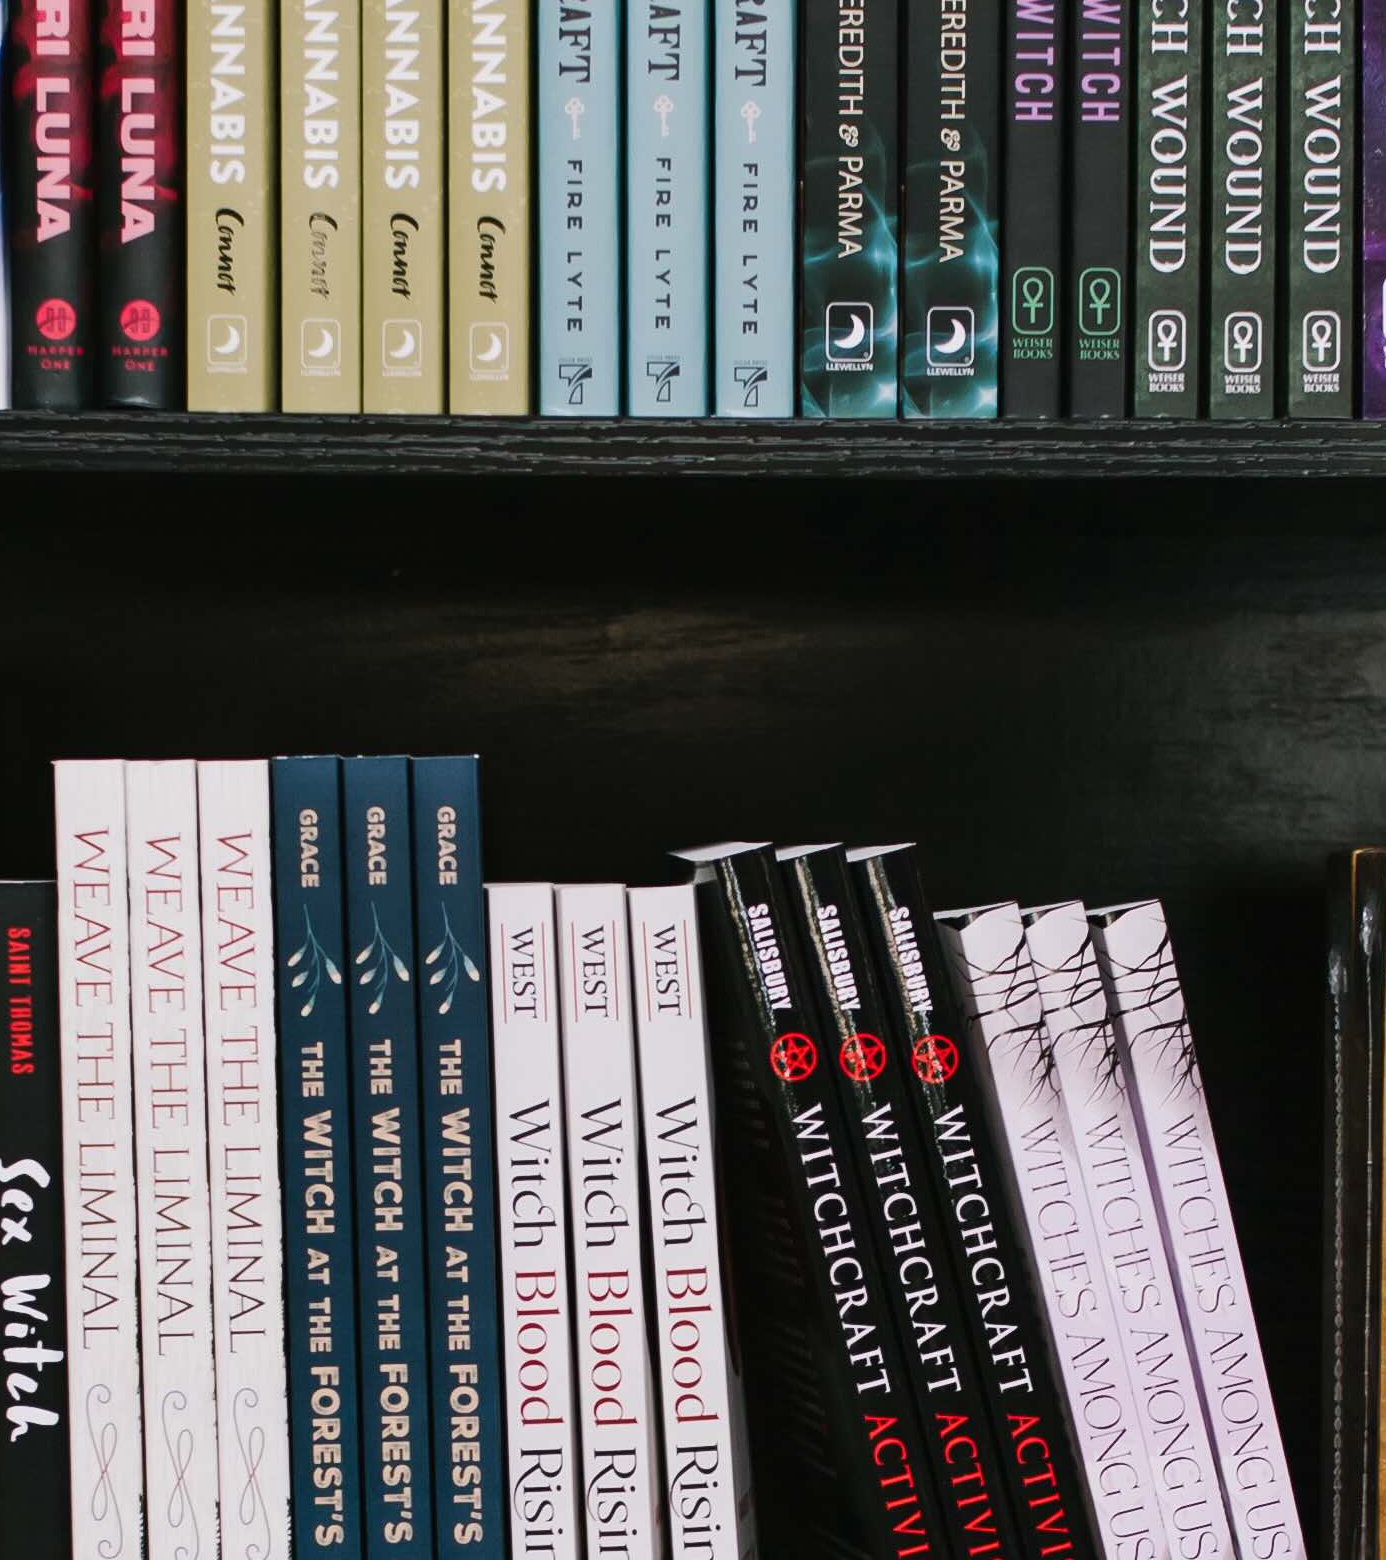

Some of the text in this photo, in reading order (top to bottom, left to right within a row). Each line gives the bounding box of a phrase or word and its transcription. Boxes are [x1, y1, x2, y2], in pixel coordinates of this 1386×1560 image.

[33, 76, 72, 243] LUNA
[1149, 76, 1189, 276] WOUND
[475, 214, 505, 303] Connor
[567, 160, 583, 333] FIRE LYTE
[825, 362, 874, 372] LLEWELLYN
[1079, 338, 1120, 349] WEISER
[1079, 349, 1120, 360] BOOKS
[509, 926, 537, 1019] WEST
[748, 902, 790, 1010] SALISBURY
[507, 1096, 557, 1249] Witch
[790, 1103, 892, 1395] WITCHCRAFT
[514, 1270, 564, 1426] Blood
